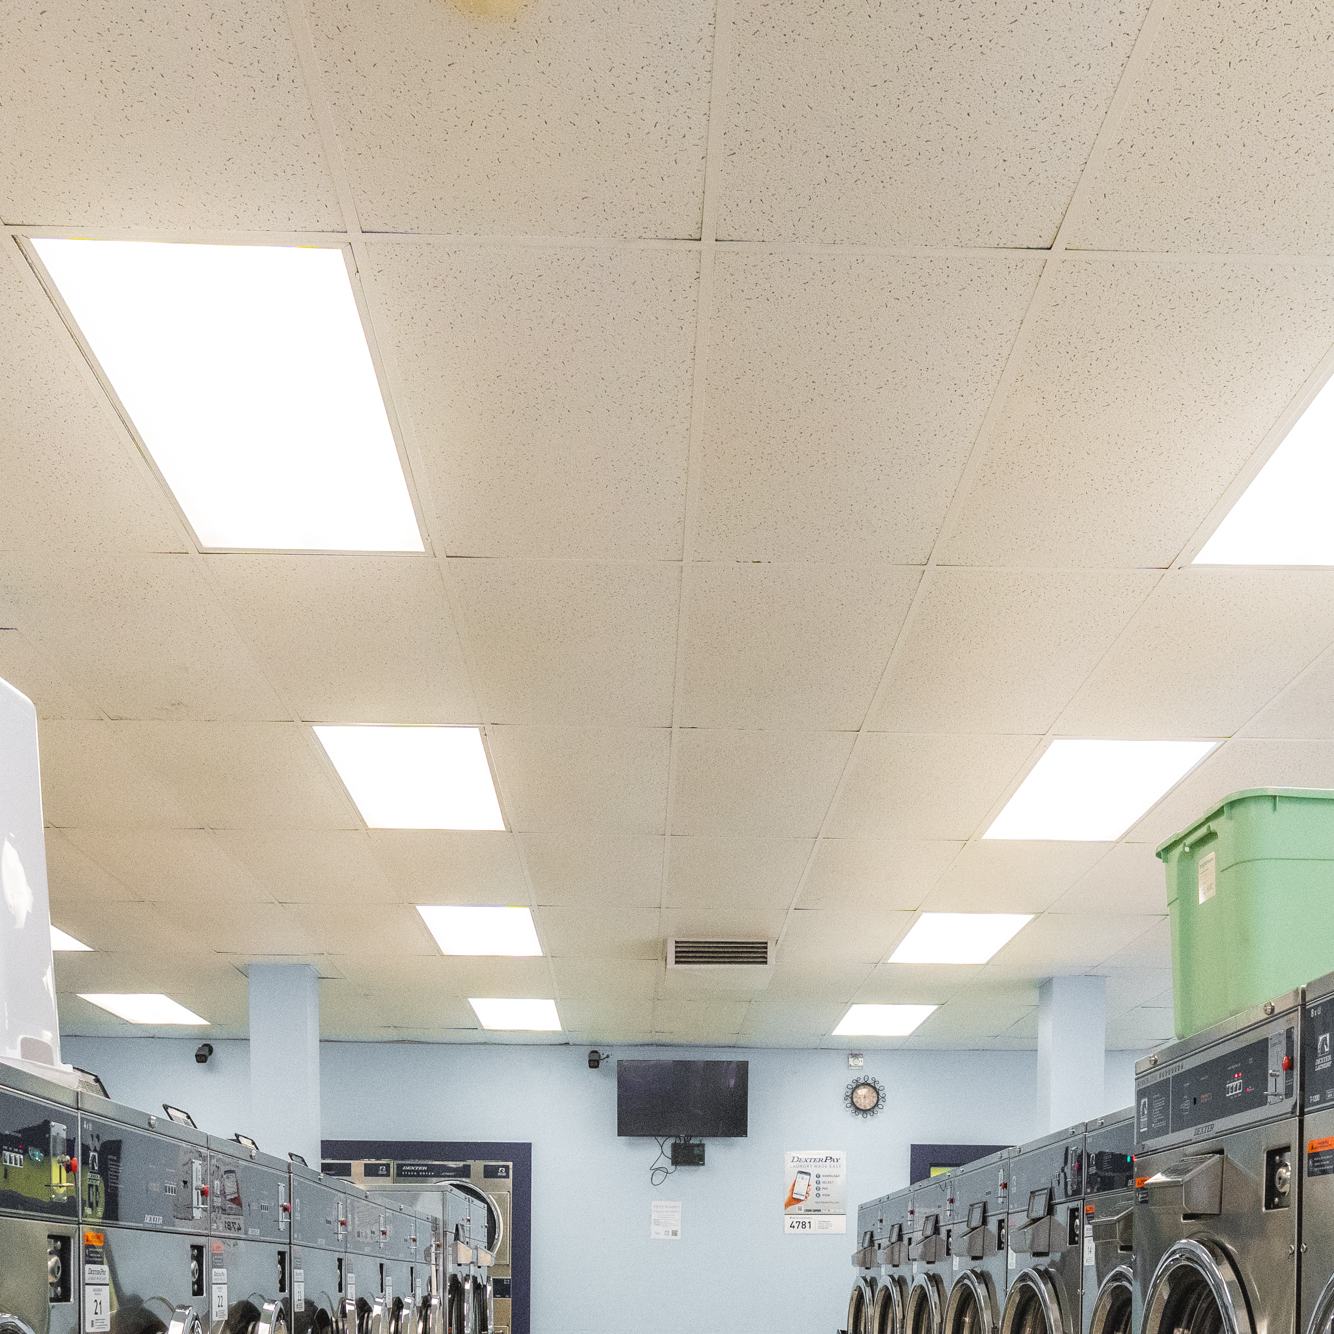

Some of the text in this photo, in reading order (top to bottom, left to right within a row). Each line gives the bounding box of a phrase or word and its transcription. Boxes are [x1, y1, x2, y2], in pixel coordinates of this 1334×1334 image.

[1194, 1124, 1214, 1136] DEXTER
[144, 1214, 163, 1225] DEXTER
[790, 1221, 812, 1229] 4781
[94, 1299, 102, 1315] 21
[217, 1295, 223, 1308] 22
